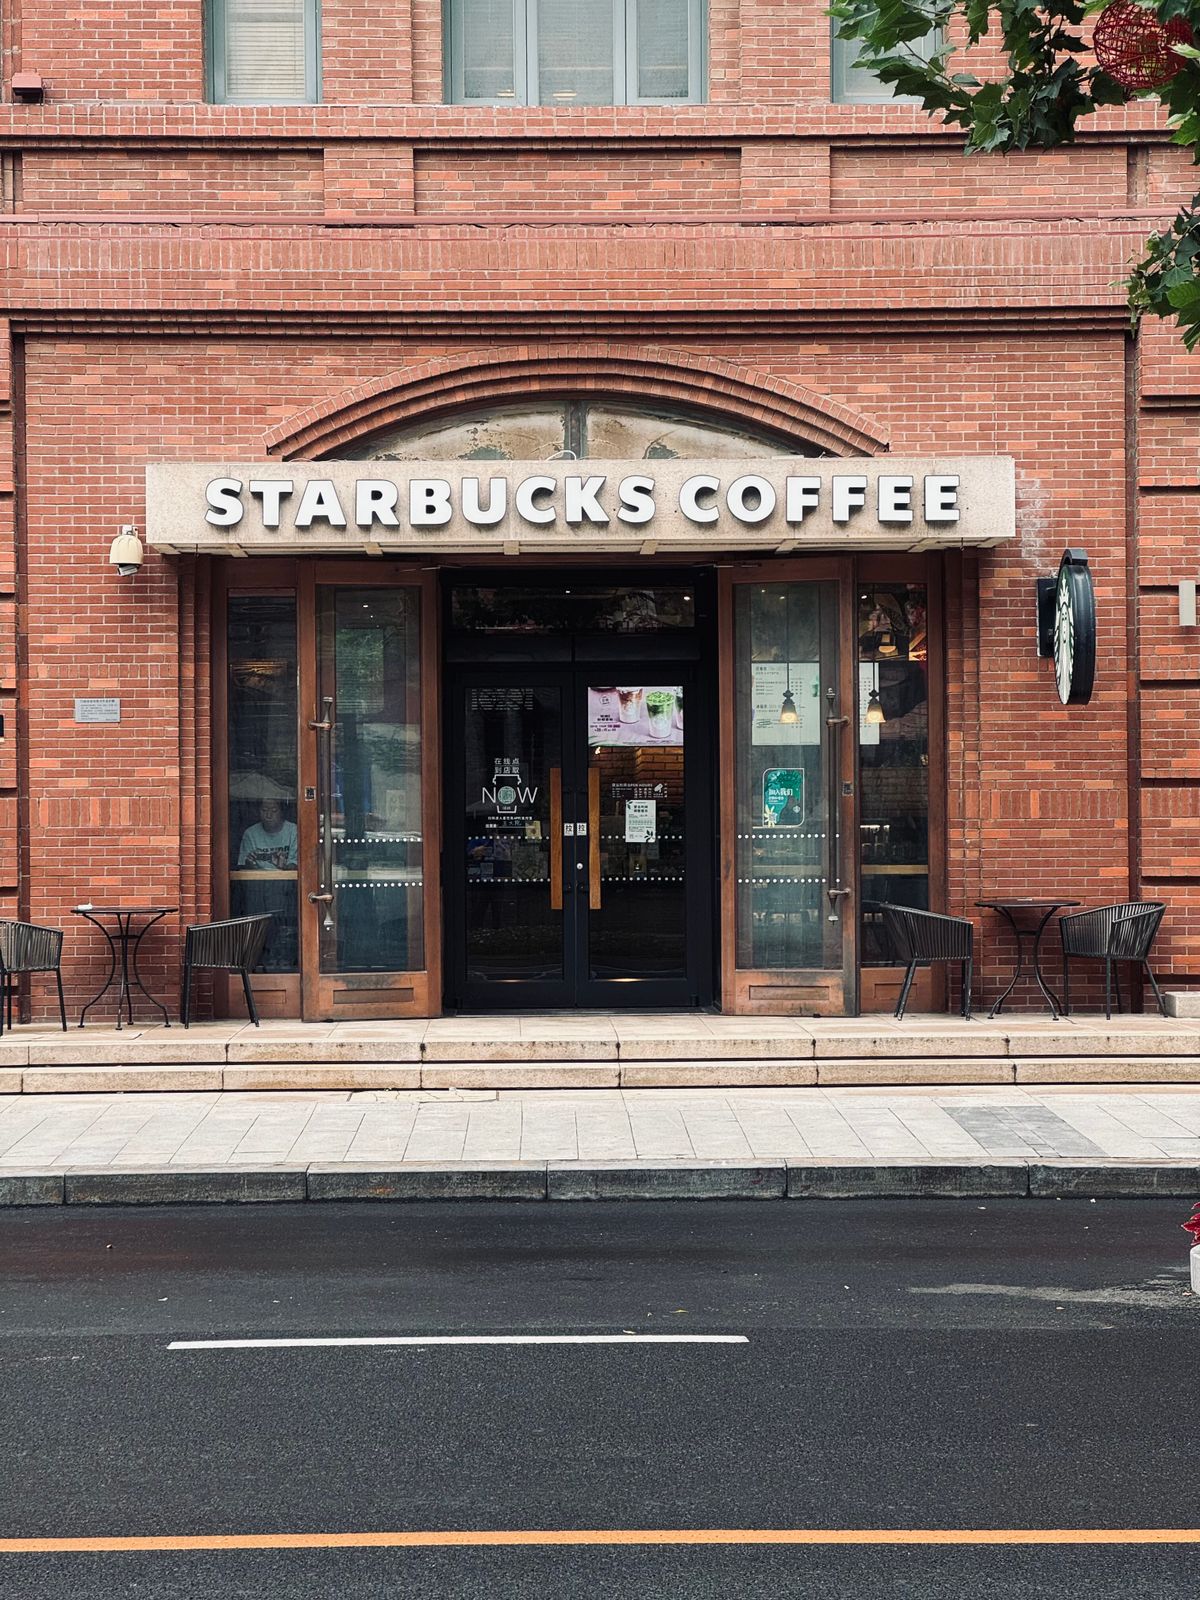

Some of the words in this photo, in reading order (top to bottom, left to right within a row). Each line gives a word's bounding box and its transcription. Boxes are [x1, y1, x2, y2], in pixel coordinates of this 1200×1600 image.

[205, 475, 656, 528] STARBUCKS
[678, 474, 961, 524] COFFEE
[494, 757, 520, 765] 在线点
[494, 766, 520, 774] 到店取
[482, 786, 538, 805] NOW
[769, 787, 793, 796] 加入我们
